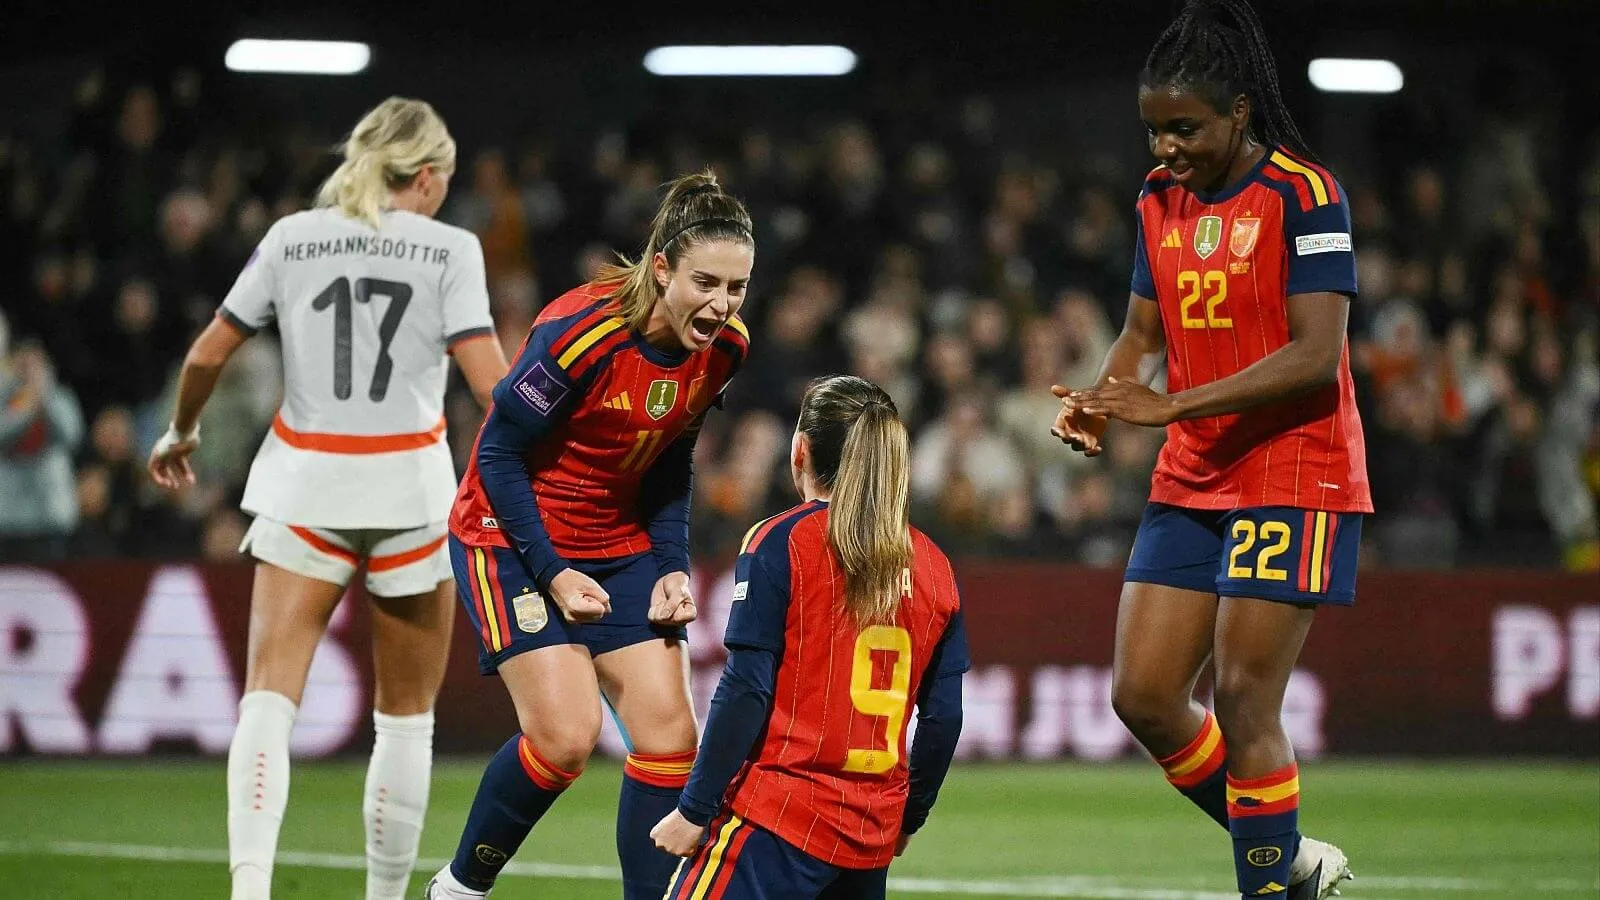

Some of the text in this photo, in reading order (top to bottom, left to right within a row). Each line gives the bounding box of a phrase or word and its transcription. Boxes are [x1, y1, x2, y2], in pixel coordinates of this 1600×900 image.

[1176, 270, 1232, 329] 22
[312, 276, 413, 402] 17
[618, 430, 664, 472] 11
[1227, 519, 1291, 581] 22
[842, 624, 912, 774] 9
